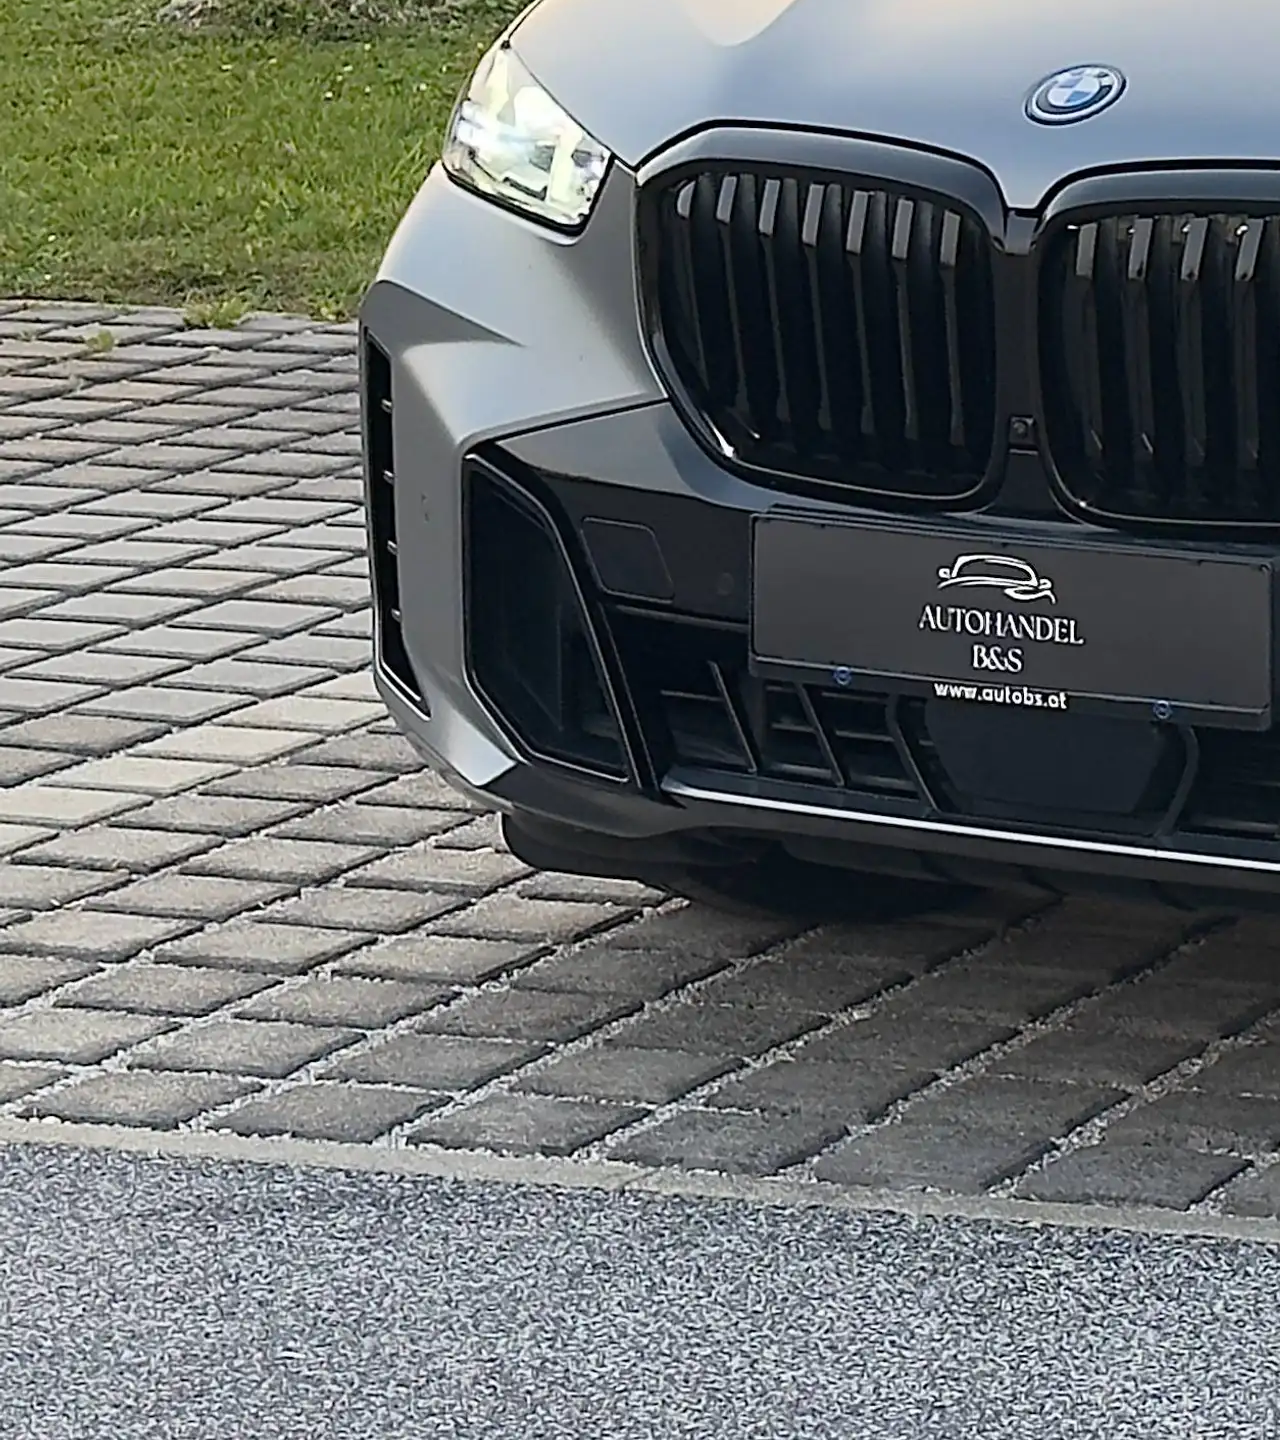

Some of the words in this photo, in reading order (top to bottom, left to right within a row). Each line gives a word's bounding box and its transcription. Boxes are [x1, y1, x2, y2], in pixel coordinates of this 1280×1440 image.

[919, 603, 1085, 645] AUTOHANDEL
[972, 643, 1023, 673] B&S
[933, 681, 1068, 710] www.autobs.at
